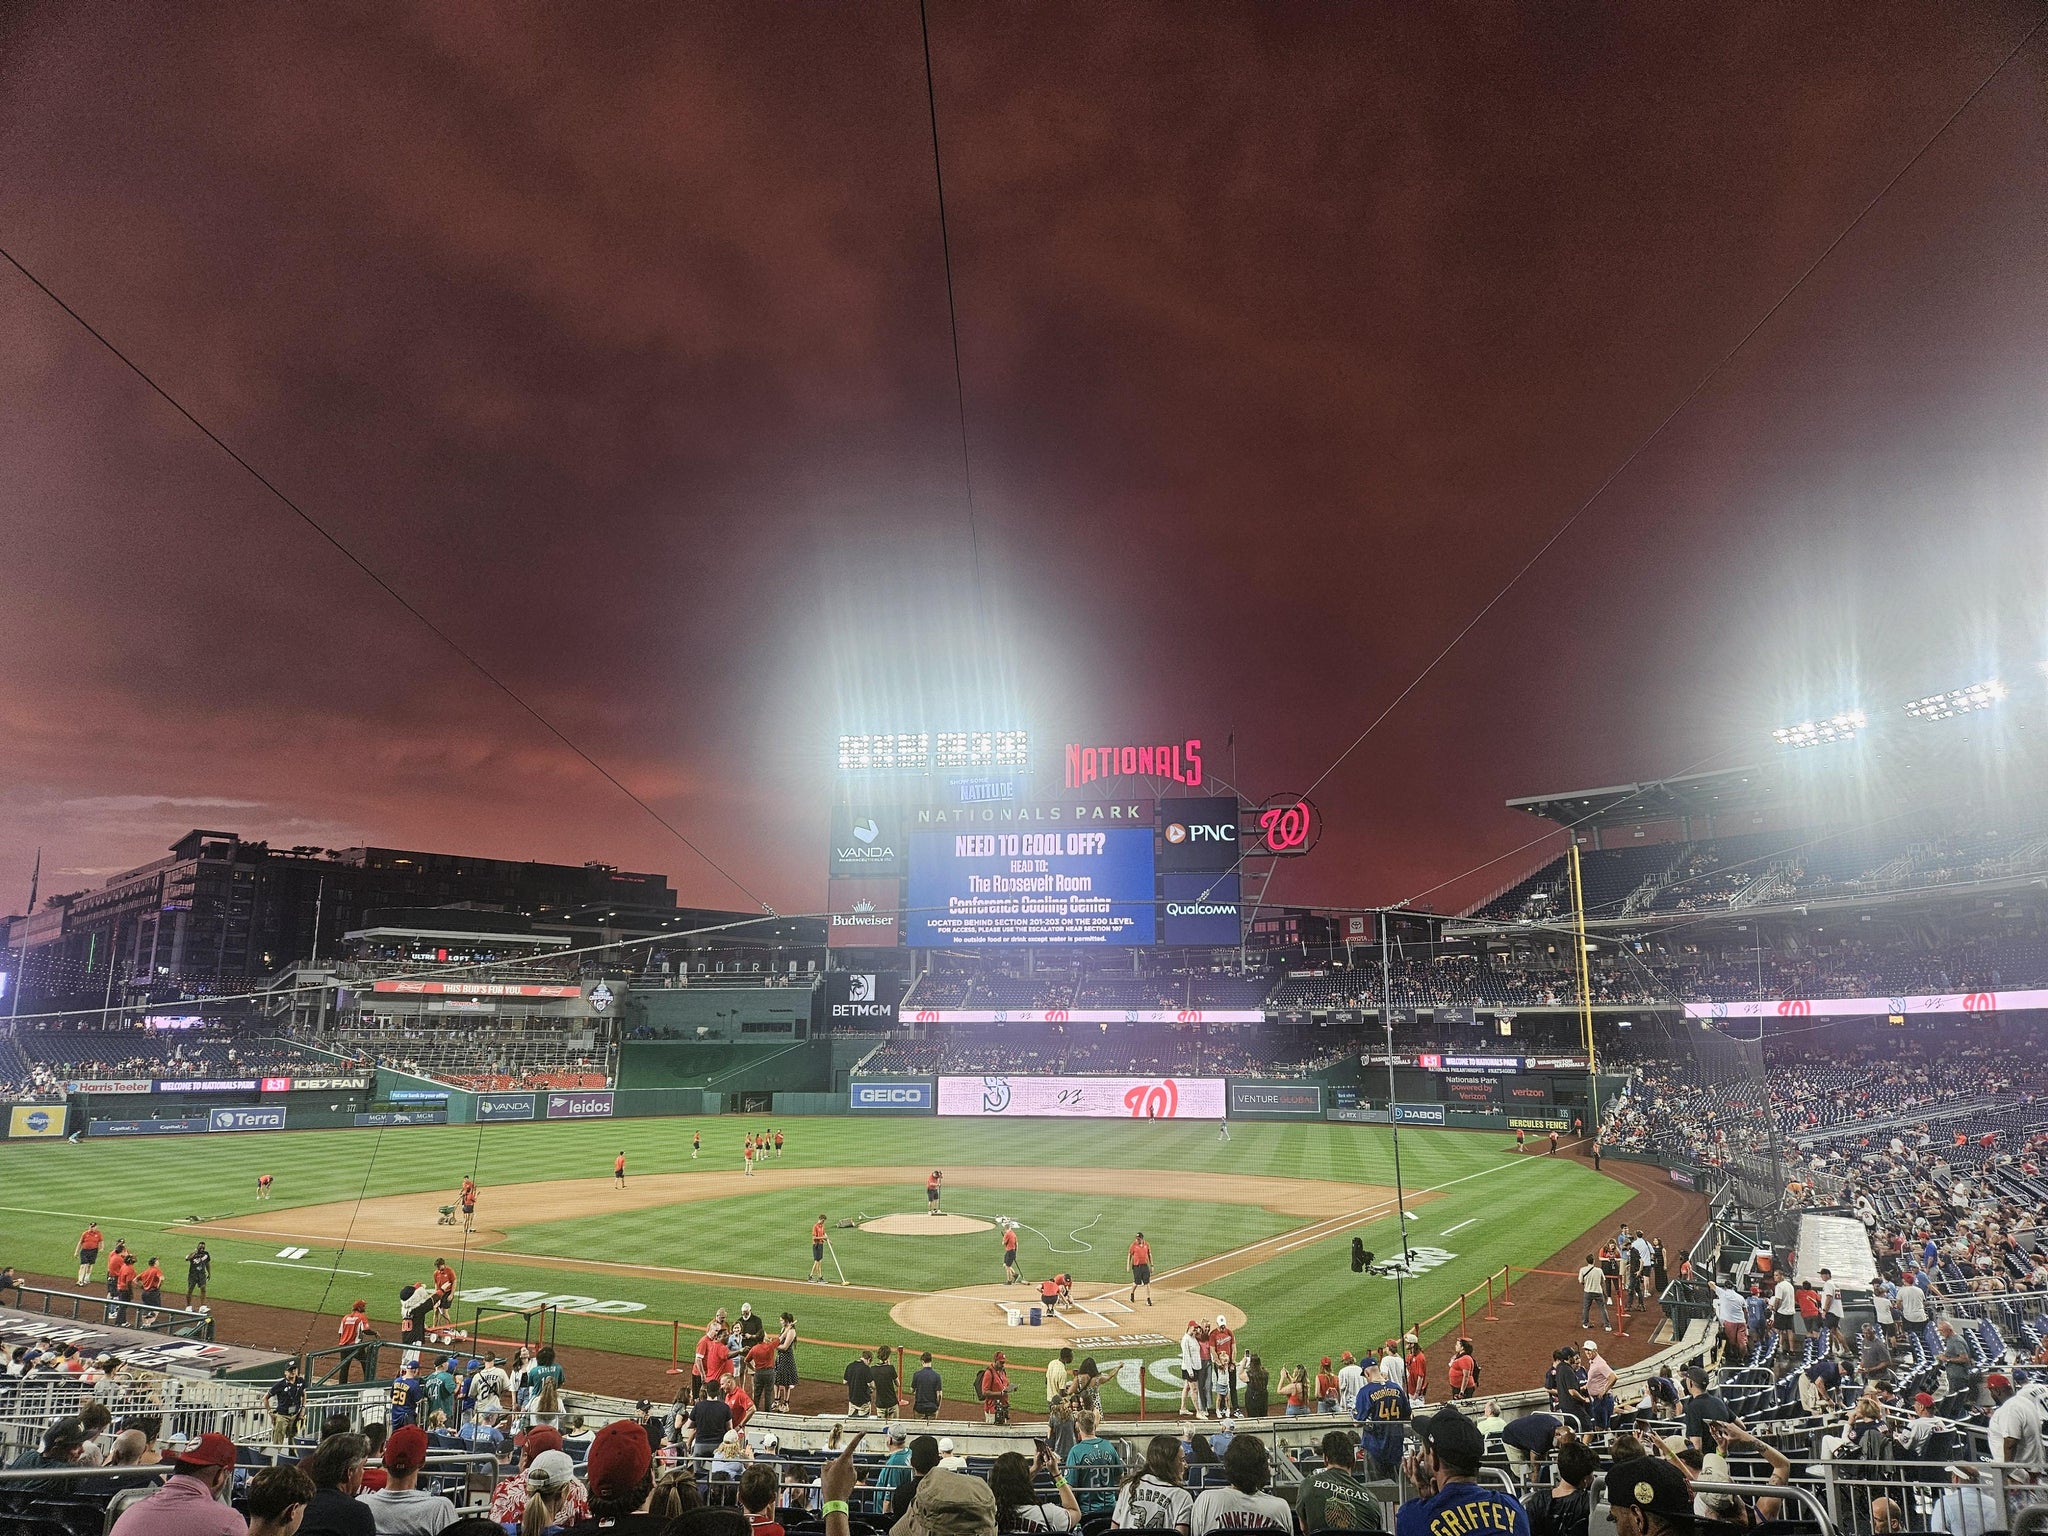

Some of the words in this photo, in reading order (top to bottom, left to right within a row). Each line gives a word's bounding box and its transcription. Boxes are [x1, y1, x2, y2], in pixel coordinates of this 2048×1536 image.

[1065, 740, 1202, 788] NATIONALS
[960, 782, 1013, 801] NATITUDE
[918, 807, 1061, 823] NATIONALS
[1075, 804, 1140, 819] PARK
[1189, 824, 1236, 842] PNC
[955, 835, 995, 857] NEED
[998, 834, 1017, 857] TO
[1022, 833, 1064, 856] COOL
[1066, 832, 1106, 855] OFF?
[837, 847, 895, 858] VANDA
[1010, 860, 1034, 873] HEAD
[1034, 860, 1048, 872] TO:
[969, 875, 990, 892] The
[993, 874, 1053, 893] Roosevelt
[1056, 874, 1092, 891] Room
[949, 896, 1019, 914] Conference
[1021, 895, 1067, 915] Cooling
[1069, 895, 1111, 913] Center
[1166, 903, 1237, 917] Qualcomm
[832, 915, 894, 926] Budweiser
[927, 919, 962, 927] LOCATED
[964, 918, 993, 926] BEHIND
[994, 918, 1027, 926] SECTION
[1029, 918, 1059, 926] 201-203
[1091, 917, 1108, 925] 200
[1109, 917, 1134, 925] LEVEL
[952, 926, 978, 934] ACCESS,
[1028, 936, 1048, 944] except
[1074, 936, 1107, 944] permitted.
[443, 984, 461, 993] THIS
[462, 984, 488, 994] BUD'S
[488, 985, 504, 994] FOR
[505, 986, 522, 994] YOU.
[832, 1004, 891, 1016] BETMGM
[1445, 1057, 1468, 1066] WELCOME
[1468, 1058, 1476, 1066] TO
[1476, 1058, 1503, 1066] NATIONALS
[1503, 1058, 1518, 1066] PARK
[160, 1081, 192, 1091] WELCOME
[192, 1081, 201, 1090] TO
[202, 1080, 238, 1090] NATIONALS
[238, 1080, 256, 1089] PARK
[266, 1079, 284, 1090] 8:31
[331, 1079, 365, 1088] FAN
[1445, 1076, 1479, 1084] Nationals
[1480, 1076, 1498, 1084] Park
[80, 1082, 113, 1091] Harris
[113, 1082, 149, 1091] Teeter
[1451, 1084, 1483, 1092] powered
[1483, 1084, 1493, 1093] by
[1512, 1087, 1545, 1097] verizon
[860, 1089, 921, 1102] GEICO
[1237, 1094, 1279, 1103] VENTURE
[1279, 1095, 1315, 1104] GLOBAL
[1459, 1092, 1487, 1100] Verizon
[346, 1104, 357, 1112] 377
[492, 1102, 530, 1110] VANDA
[569, 1099, 611, 1113] leidos
[236, 1113, 279, 1125] Terra
[1404, 1110, 1442, 1119] DABOS
[1559, 1109, 1568, 1118] 335
[1509, 1119, 1544, 1128] HERCULES
[1545, 1120, 1568, 1130] FENCE
[1068, 1336, 1116, 1344] VOTE
[1118, 1333, 1165, 1341] NATS
[1076, 1339, 1173, 1349] nationals.com
[537, 1366, 556, 1375] NAYLOR
[428, 1387, 439, 1400] 44
[480, 1382, 498, 1400] 24
[392, 1390, 406, 1405] 29
[1379, 1399, 1400, 1420] 44
[1084, 1450, 1113, 1466] RALEIGH
[1090, 1467, 1110, 1488] 29
[1314, 1480, 1370, 1502] BODEGAS
[1130, 1504, 1166, 1529] 34
[1430, 1501, 1517, 1536] GRIFFEY
